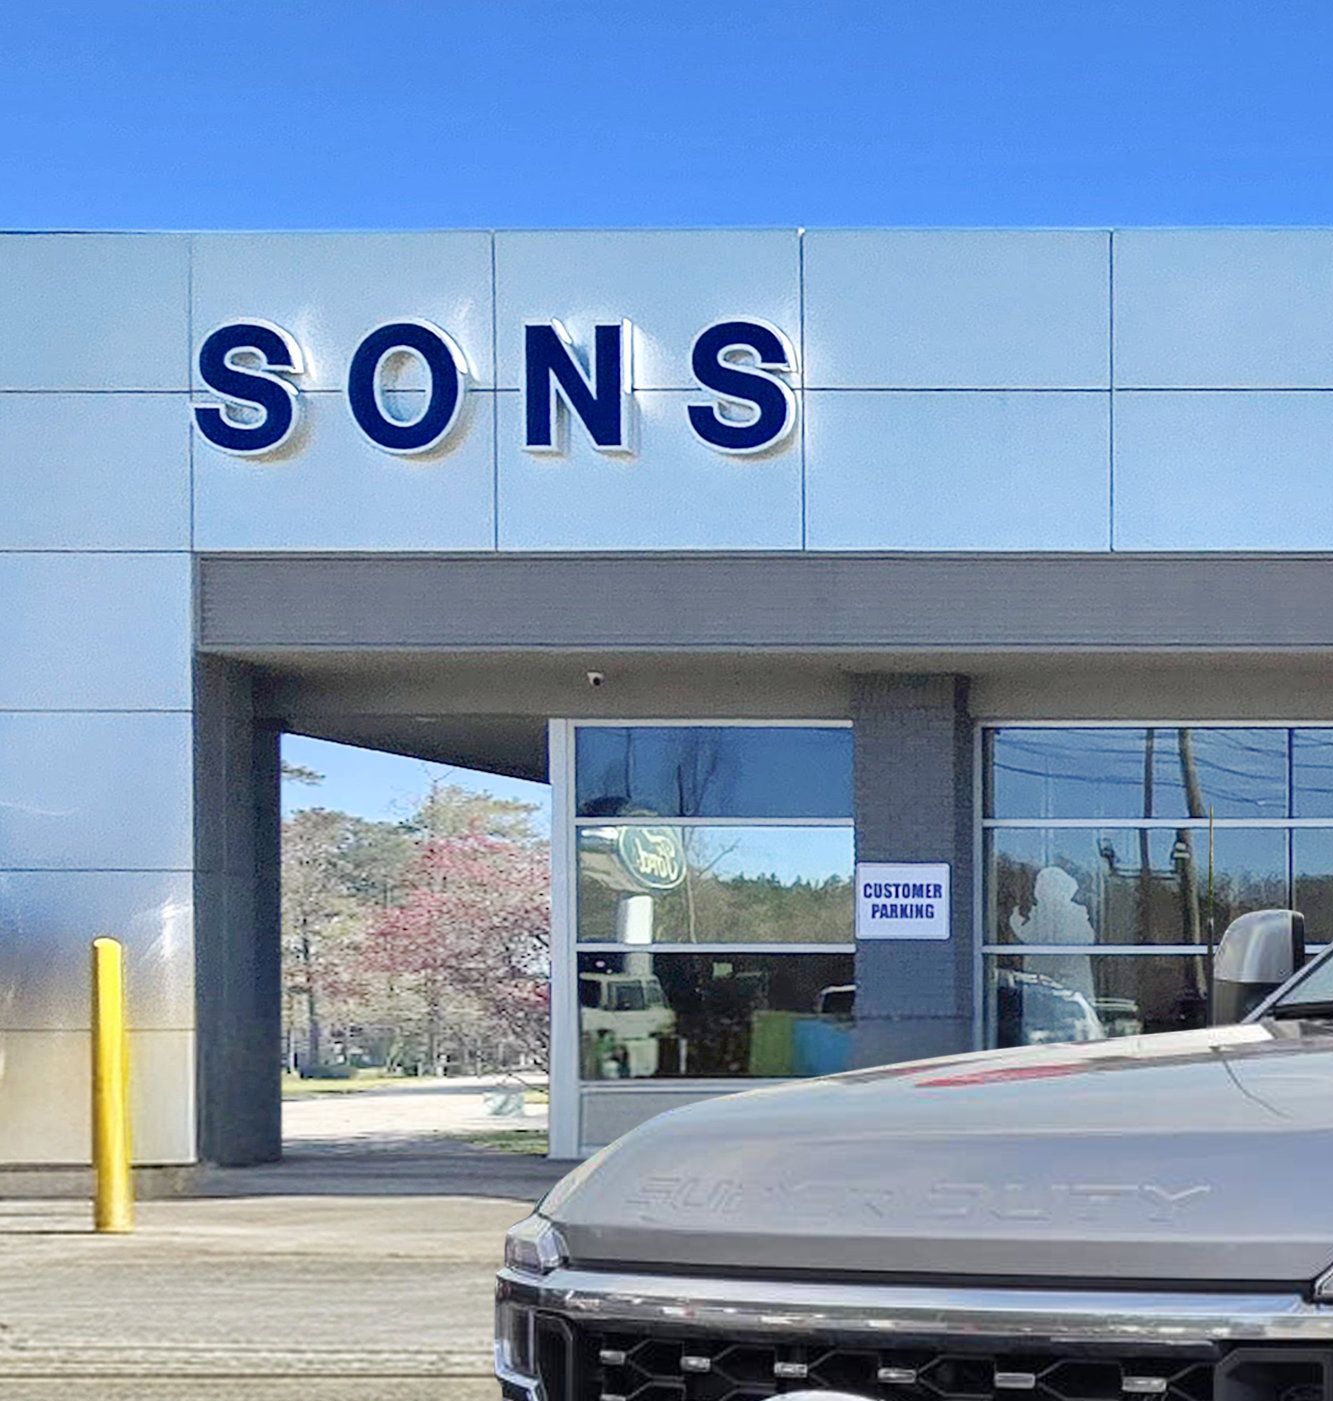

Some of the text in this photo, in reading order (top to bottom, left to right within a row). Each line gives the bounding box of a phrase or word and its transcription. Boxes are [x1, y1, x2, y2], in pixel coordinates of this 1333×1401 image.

[194, 320, 797, 455] SONS
[863, 882, 943, 899] CUSTOMER
[871, 903, 935, 919] PARKING
